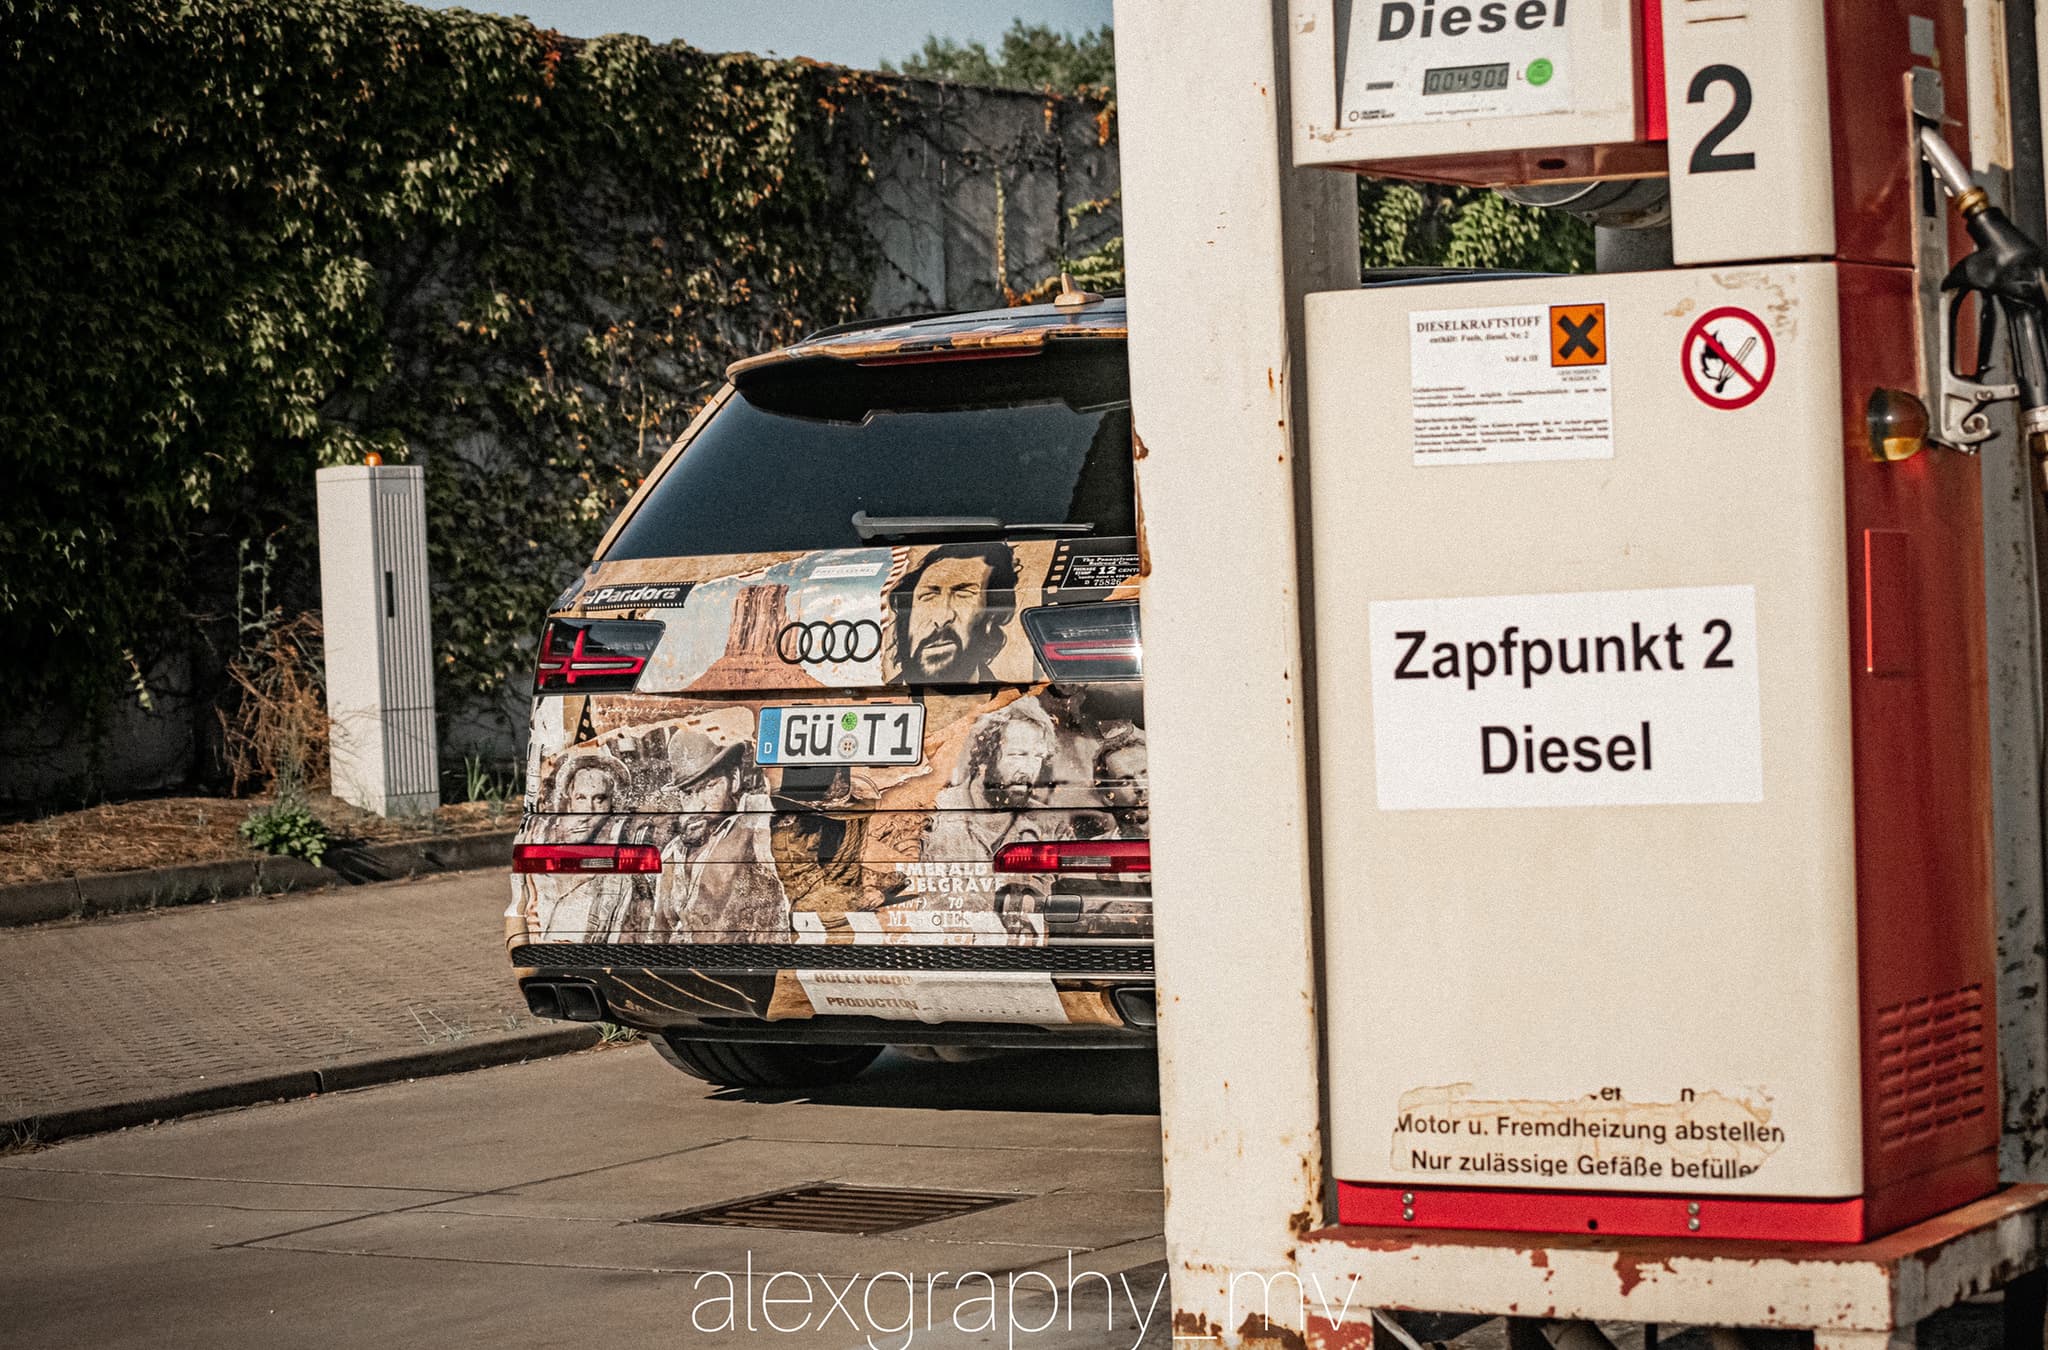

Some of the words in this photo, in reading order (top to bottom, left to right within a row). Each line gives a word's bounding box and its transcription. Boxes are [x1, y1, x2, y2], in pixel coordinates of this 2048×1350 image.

[1378, 0, 1567, 42] Diesel
[1686, 63, 1756, 174] 2
[1416, 316, 1541, 333] DIESELKRAFTSTOFF
[1098, 566, 1117, 575] 12
[597, 587, 679, 604] Pandora
[1394, 622, 1685, 690] Zapfpunkt
[1702, 618, 1735, 669] 2
[764, 742, 772, 754] D
[1481, 720, 1652, 774] Diesel
[826, 996, 919, 1010] PRODUCTION
[1396, 1114, 1461, 1134] Motor
[1468, 1119, 1488, 1136] u.
[1496, 1115, 1667, 1145] Fremdheizung
[1674, 1119, 1785, 1143] abstellen
[1411, 1149, 1452, 1170] Nur
[1458, 1151, 1569, 1177] zulässige
[1577, 1154, 1663, 1177] Gefäße
